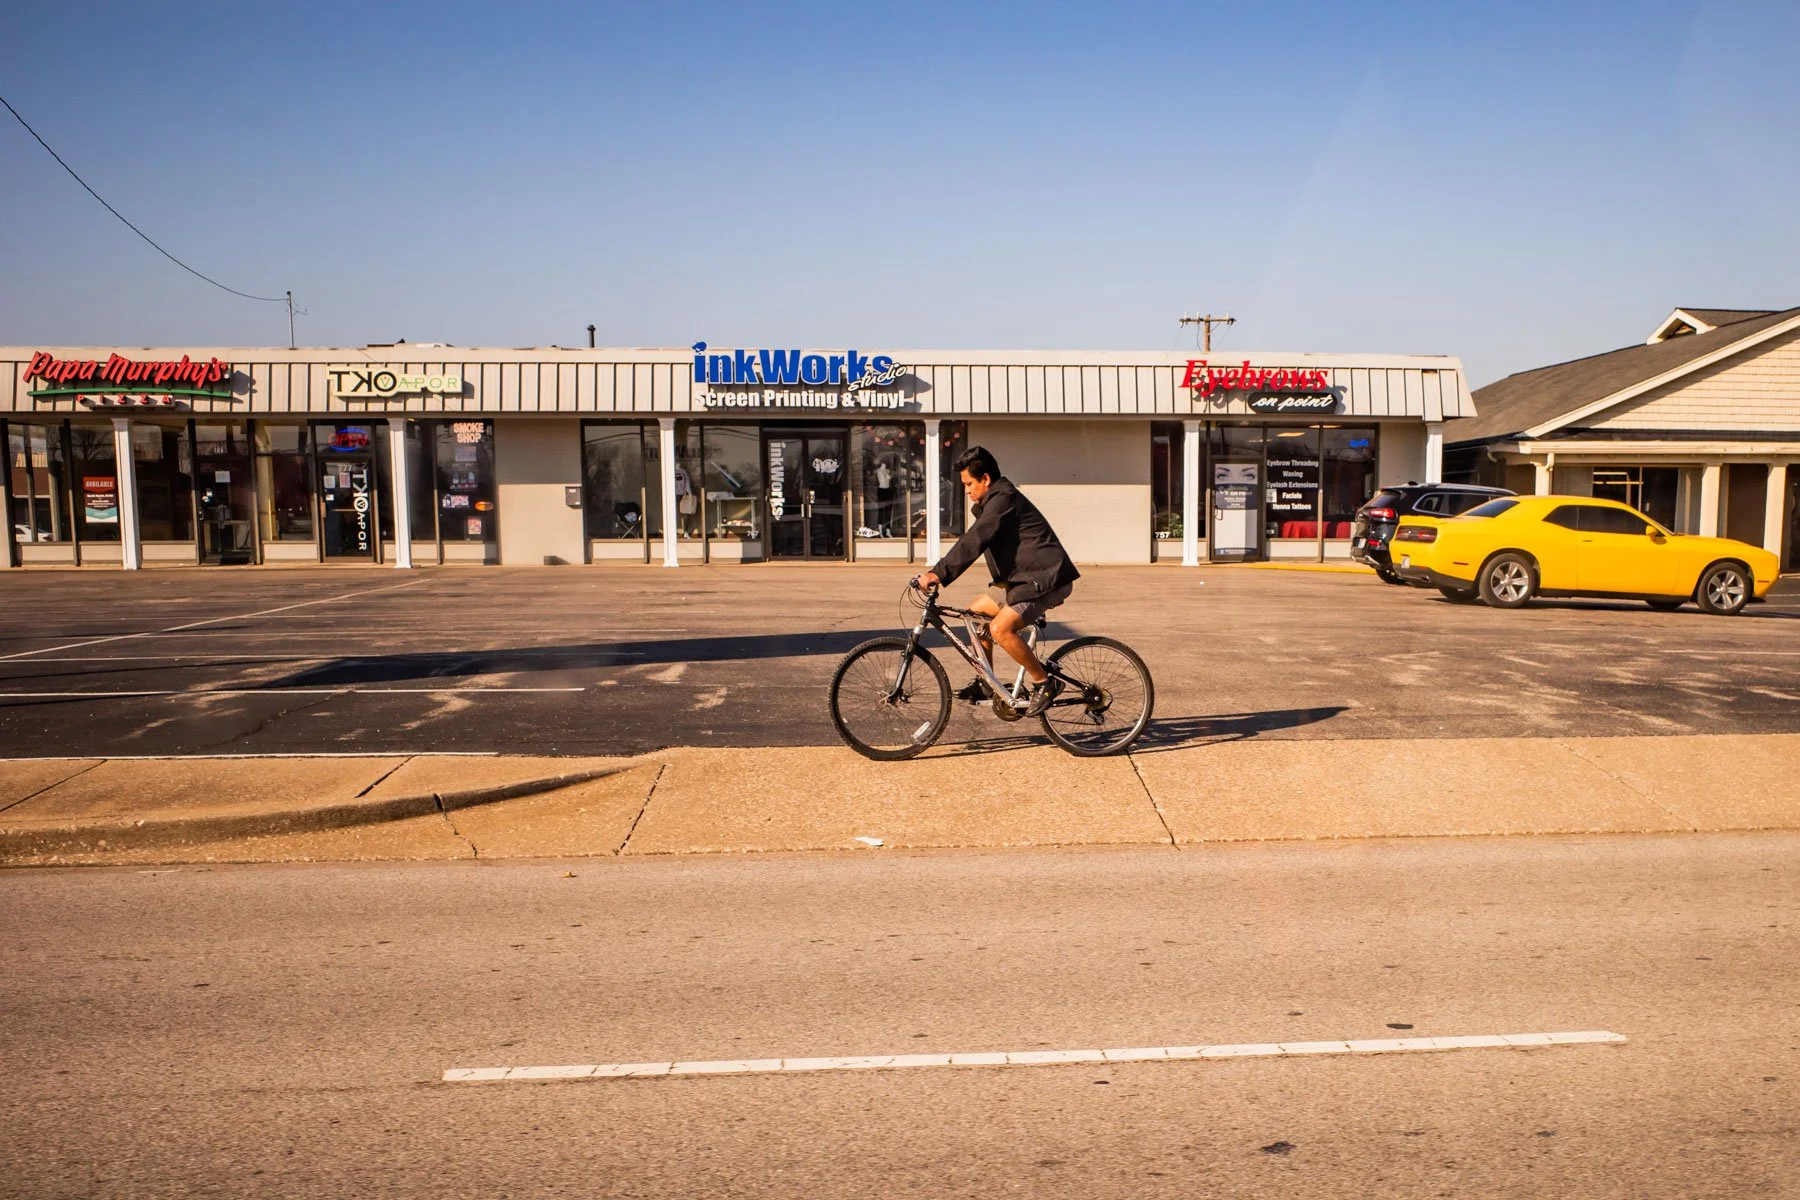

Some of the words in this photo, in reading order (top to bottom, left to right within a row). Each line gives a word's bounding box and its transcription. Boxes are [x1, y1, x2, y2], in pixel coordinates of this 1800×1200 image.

[692, 341, 896, 386] inkWorks
[23, 351, 98, 384] Papa
[101, 352, 229, 388] Murphy's
[848, 362, 907, 392] studio
[1178, 360, 1328, 398] Eyebrows
[77, 393, 173, 405] PIZZA
[694, 388, 760, 408] Screen
[763, 389, 838, 409] Printing
[841, 391, 855, 408] &
[858, 389, 905, 410] Vinyl
[1252, 398, 1279, 408] on
[1278, 394, 1334, 411] point
[453, 422, 484, 433] SMOKE
[328, 432, 369, 447] OPEN
[457, 432, 481, 443] SHOP
[1266, 459, 1290, 467] Eyebrow
[1291, 459, 1319, 468] Threading
[1282, 470, 1303, 479] Waxing
[85, 480, 113, 488] AVAILABLE
[1266, 481, 1288, 489] Eyelash
[1291, 502, 1312, 510] Tattoos
[1154, 531, 1171, 539] 757
